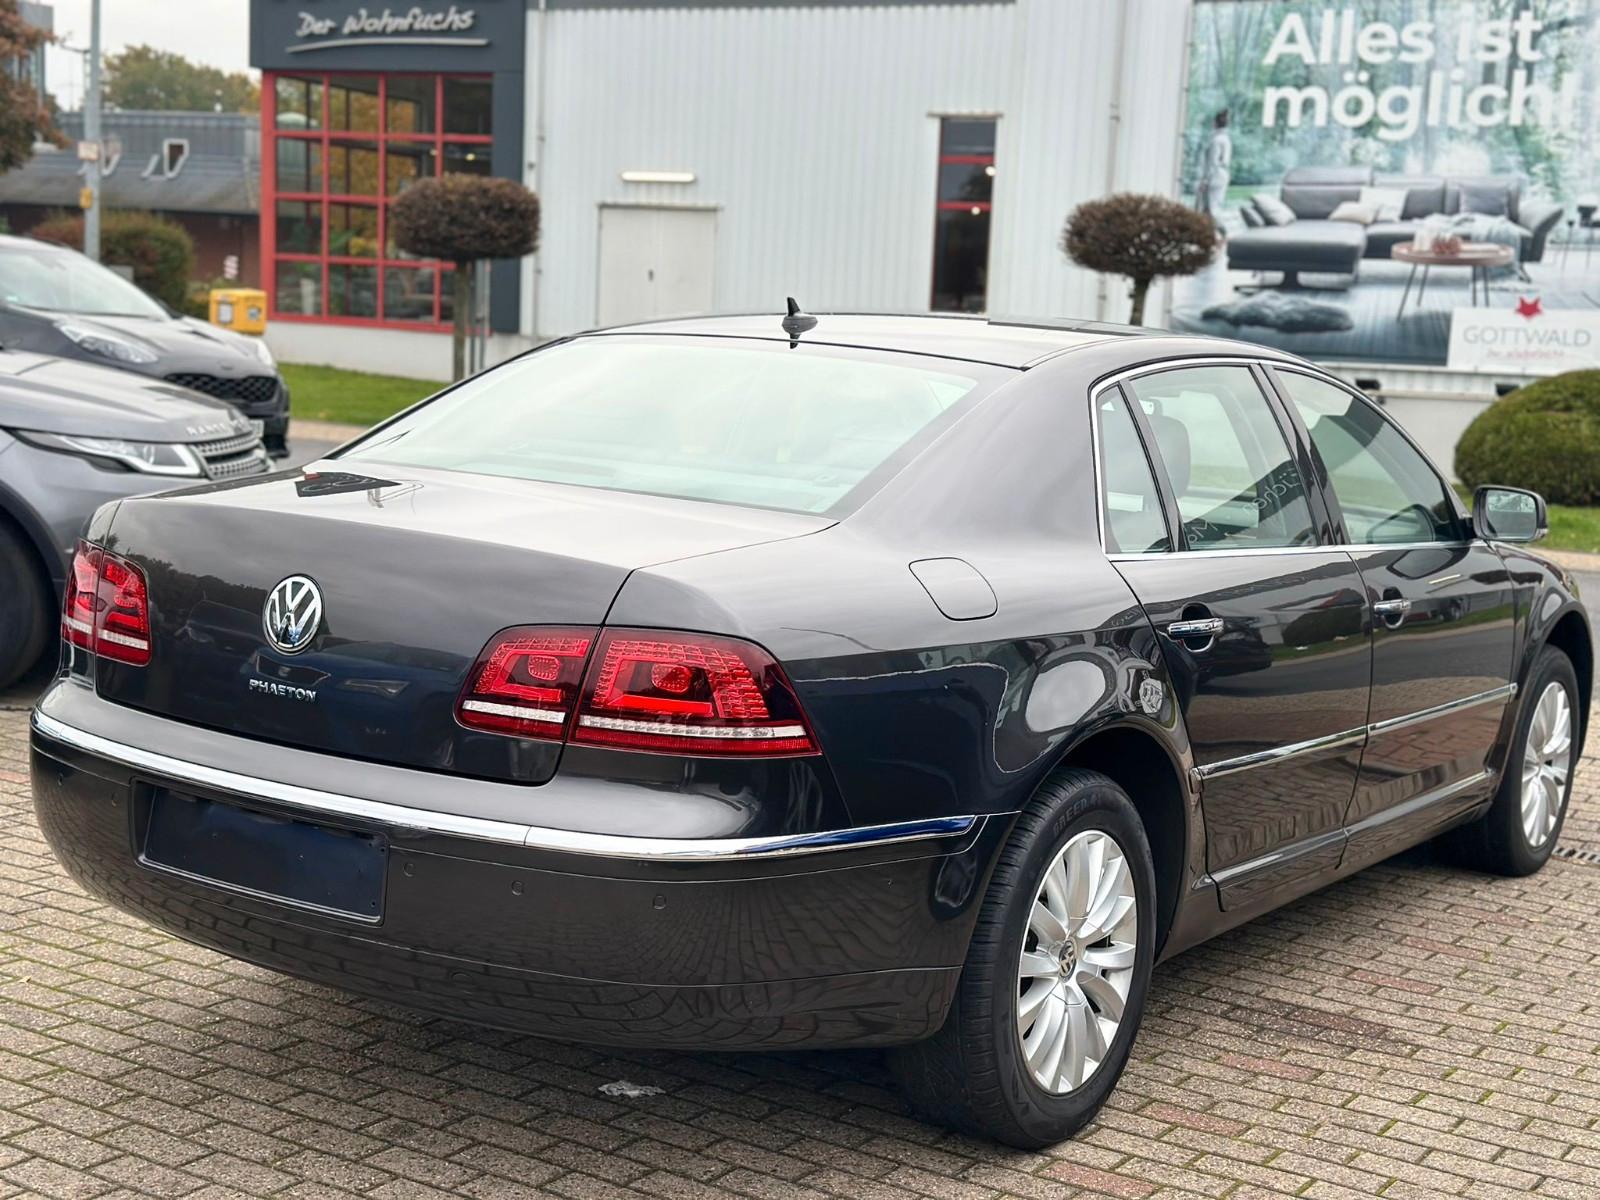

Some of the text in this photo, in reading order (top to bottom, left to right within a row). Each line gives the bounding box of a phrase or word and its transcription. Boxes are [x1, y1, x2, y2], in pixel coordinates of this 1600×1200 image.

[295, 6, 474, 37] Der Wohnfuchs
[1263, 2, 1543, 65] Alles ist
[1261, 70, 1581, 141] möglich!
[1463, 325, 1592, 348] GOTTWALD
[249, 678, 317, 702] PHAETON
